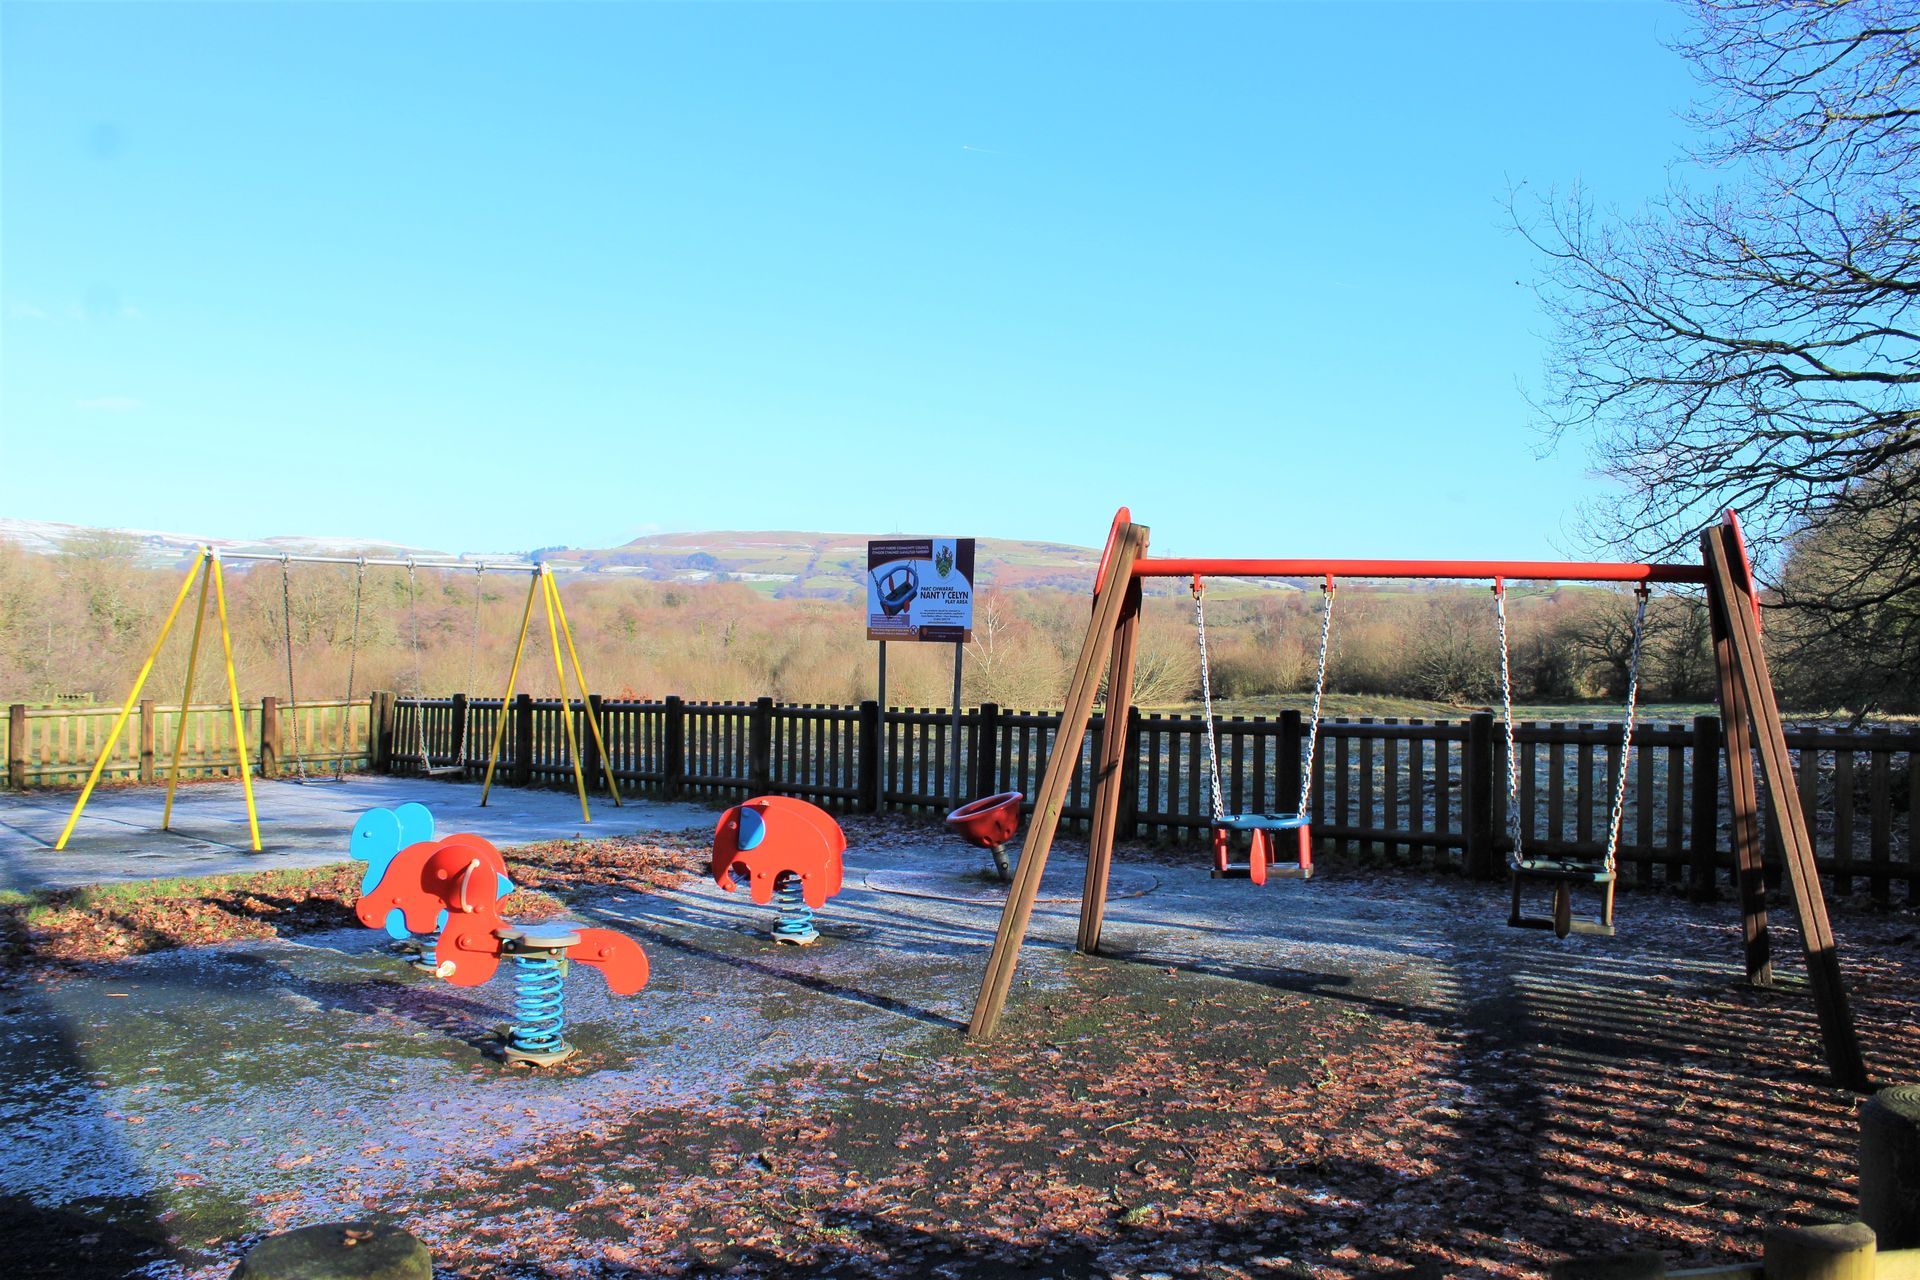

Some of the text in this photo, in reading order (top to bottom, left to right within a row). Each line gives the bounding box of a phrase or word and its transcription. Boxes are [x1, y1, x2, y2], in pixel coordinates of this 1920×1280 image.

[921, 591, 968, 599] NANT Y CELYN
